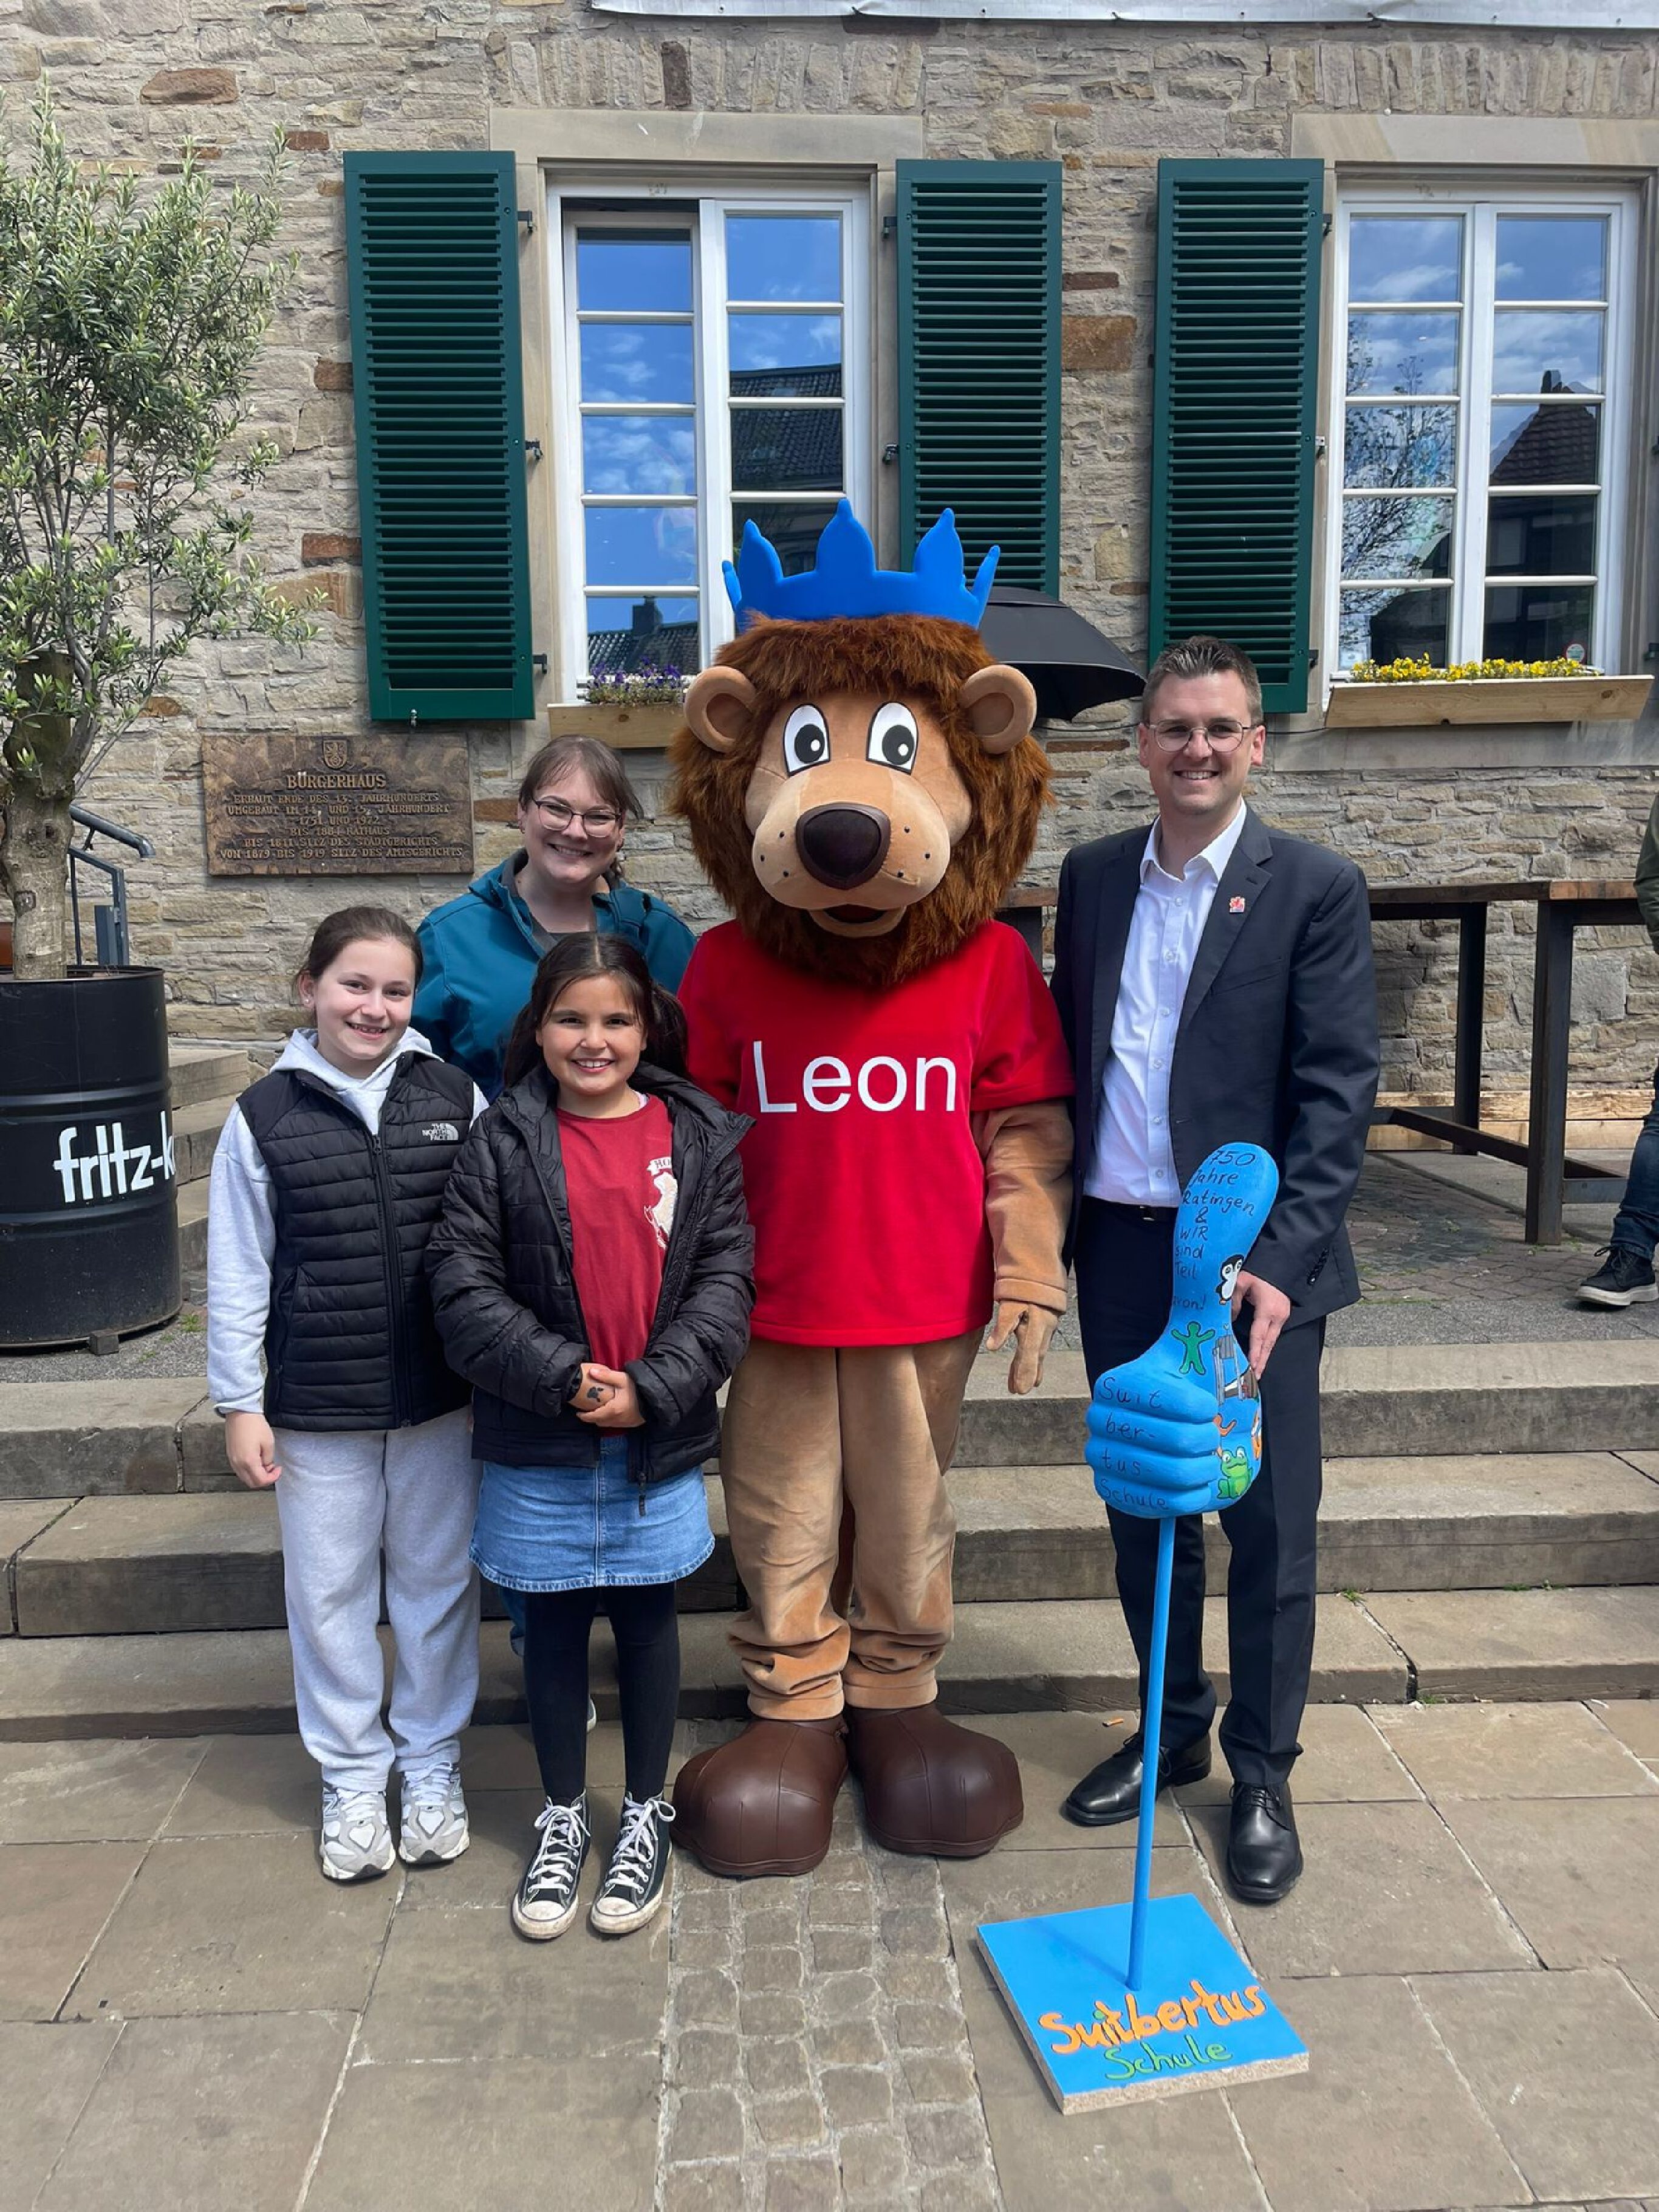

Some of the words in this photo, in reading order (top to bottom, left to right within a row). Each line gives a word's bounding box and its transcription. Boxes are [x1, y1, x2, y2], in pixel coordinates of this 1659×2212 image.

[287, 772, 388, 789] BÜRGERHAUS
[233, 795, 273, 803] ERBAUT
[278, 795, 304, 803] ENDE
[309, 794, 329, 803] DES
[360, 793, 439, 802] JAHRHUNDERTS
[227, 806, 279, 815] UMGEBAUT
[329, 805, 349, 814] UND
[378, 803, 451, 813] JAHRHUNDERT
[329, 817, 349, 825] UND
[290, 827, 309, 835] BIS
[346, 826, 389, 835] RATHAUS
[244, 838, 264, 847] BIS
[330, 838, 351, 846] DES
[355, 837, 438, 845] STADTGERICHTS
[221, 849, 241, 858] VON
[276, 849, 295, 858] BIS
[362, 847, 383, 857] DES
[386, 847, 463, 857] AMTSGERICHTS
[753, 1041, 956, 1113] Leon
[1209, 1150, 1256, 1166] 750
[1182, 1190, 1254, 1216] Ratingen
[1196, 1206, 1209, 1224] &
[1180, 1226, 1209, 1241] WIR
[1175, 1245, 1204, 1259] sind
[1096, 1478, 1169, 1510] Schule
[1038, 1979, 1267, 2055] Suitbertus
[1104, 2034, 1233, 2080] Schule
